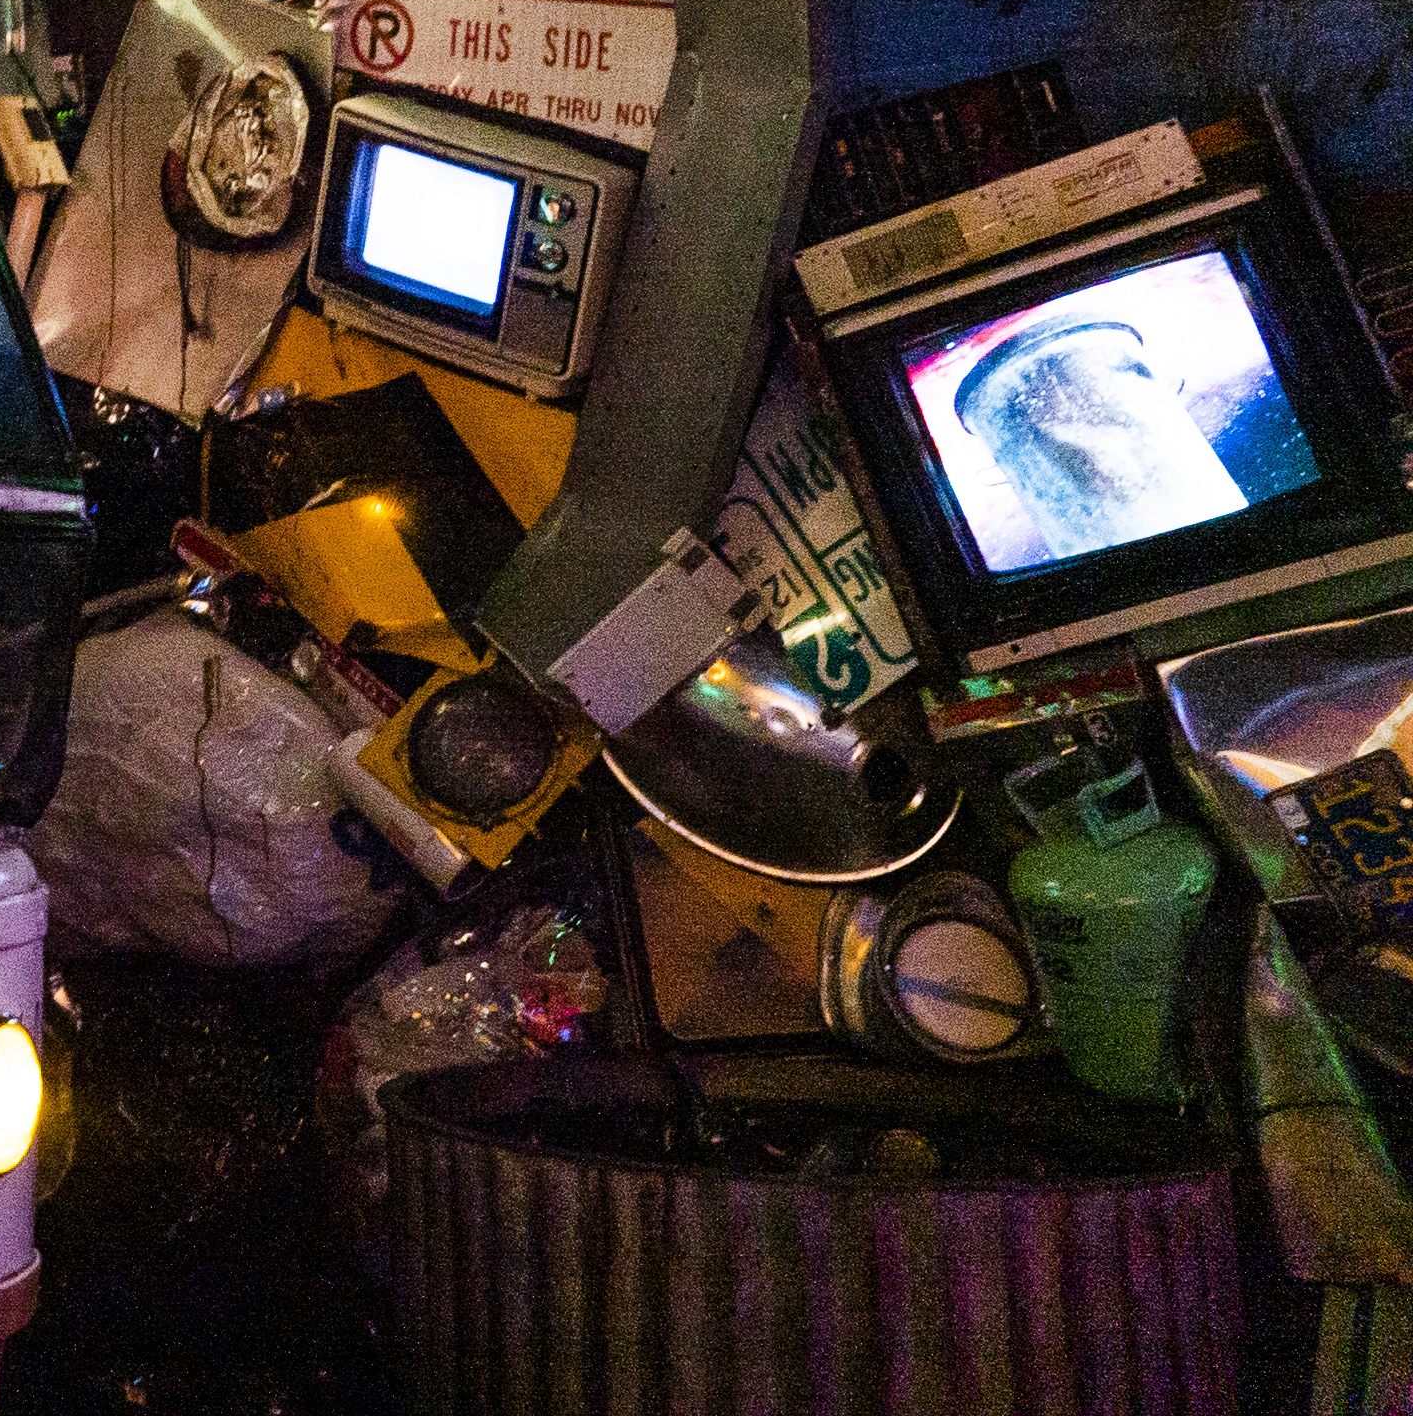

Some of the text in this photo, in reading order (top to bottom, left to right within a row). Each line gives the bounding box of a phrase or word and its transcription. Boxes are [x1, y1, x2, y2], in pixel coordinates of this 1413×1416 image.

[448, 19, 614, 72] THIS SIDE
[486, 89, 530, 116] APR
[544, 94, 602, 123] THRU
[815, 632, 853, 693] 2
